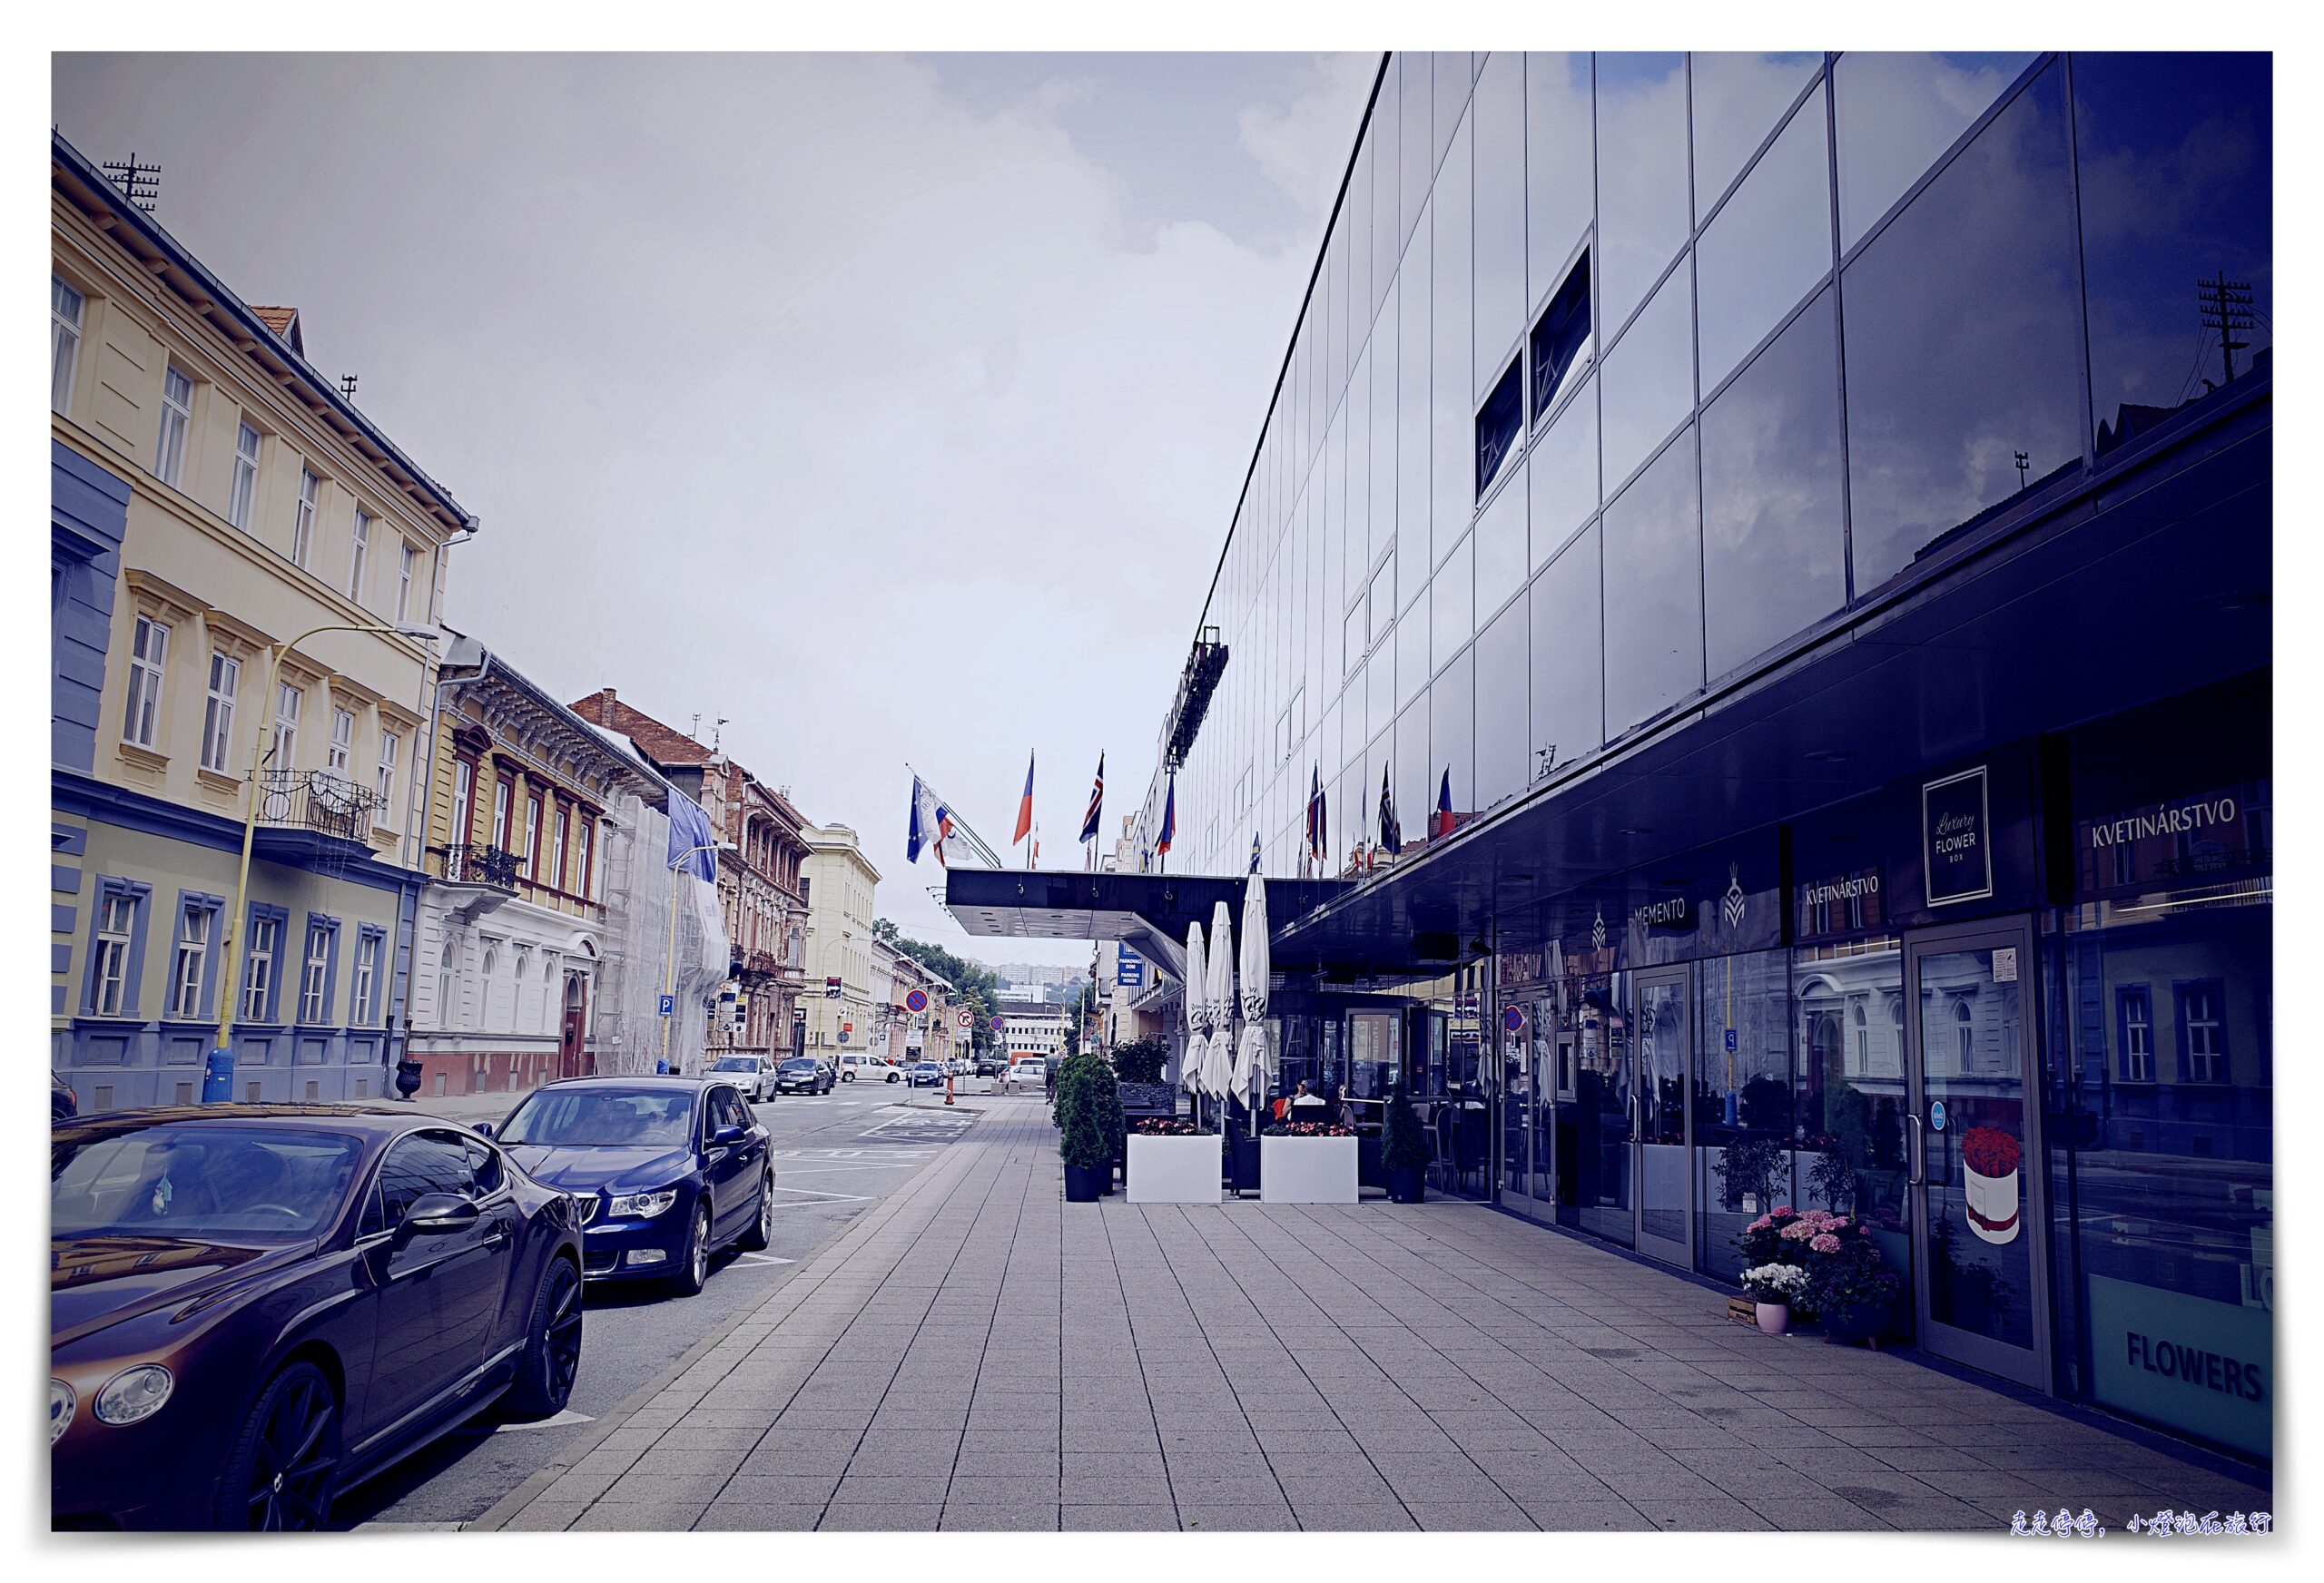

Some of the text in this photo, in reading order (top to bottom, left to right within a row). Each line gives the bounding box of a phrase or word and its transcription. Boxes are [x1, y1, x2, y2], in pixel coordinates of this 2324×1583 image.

[1936, 811, 1974, 835] Luxury
[2093, 798, 2235, 848] KVETINÁRSTVO
[1935, 832, 1975, 854] FLOWER
[1949, 853, 1963, 863] BOX
[1806, 876, 1878, 906] KVETINÁRSTVO
[1634, 898, 1685, 927] MEMENTO
[662, 999, 670, 1011] P
[2126, 1331, 2262, 1402] FLOWERS
